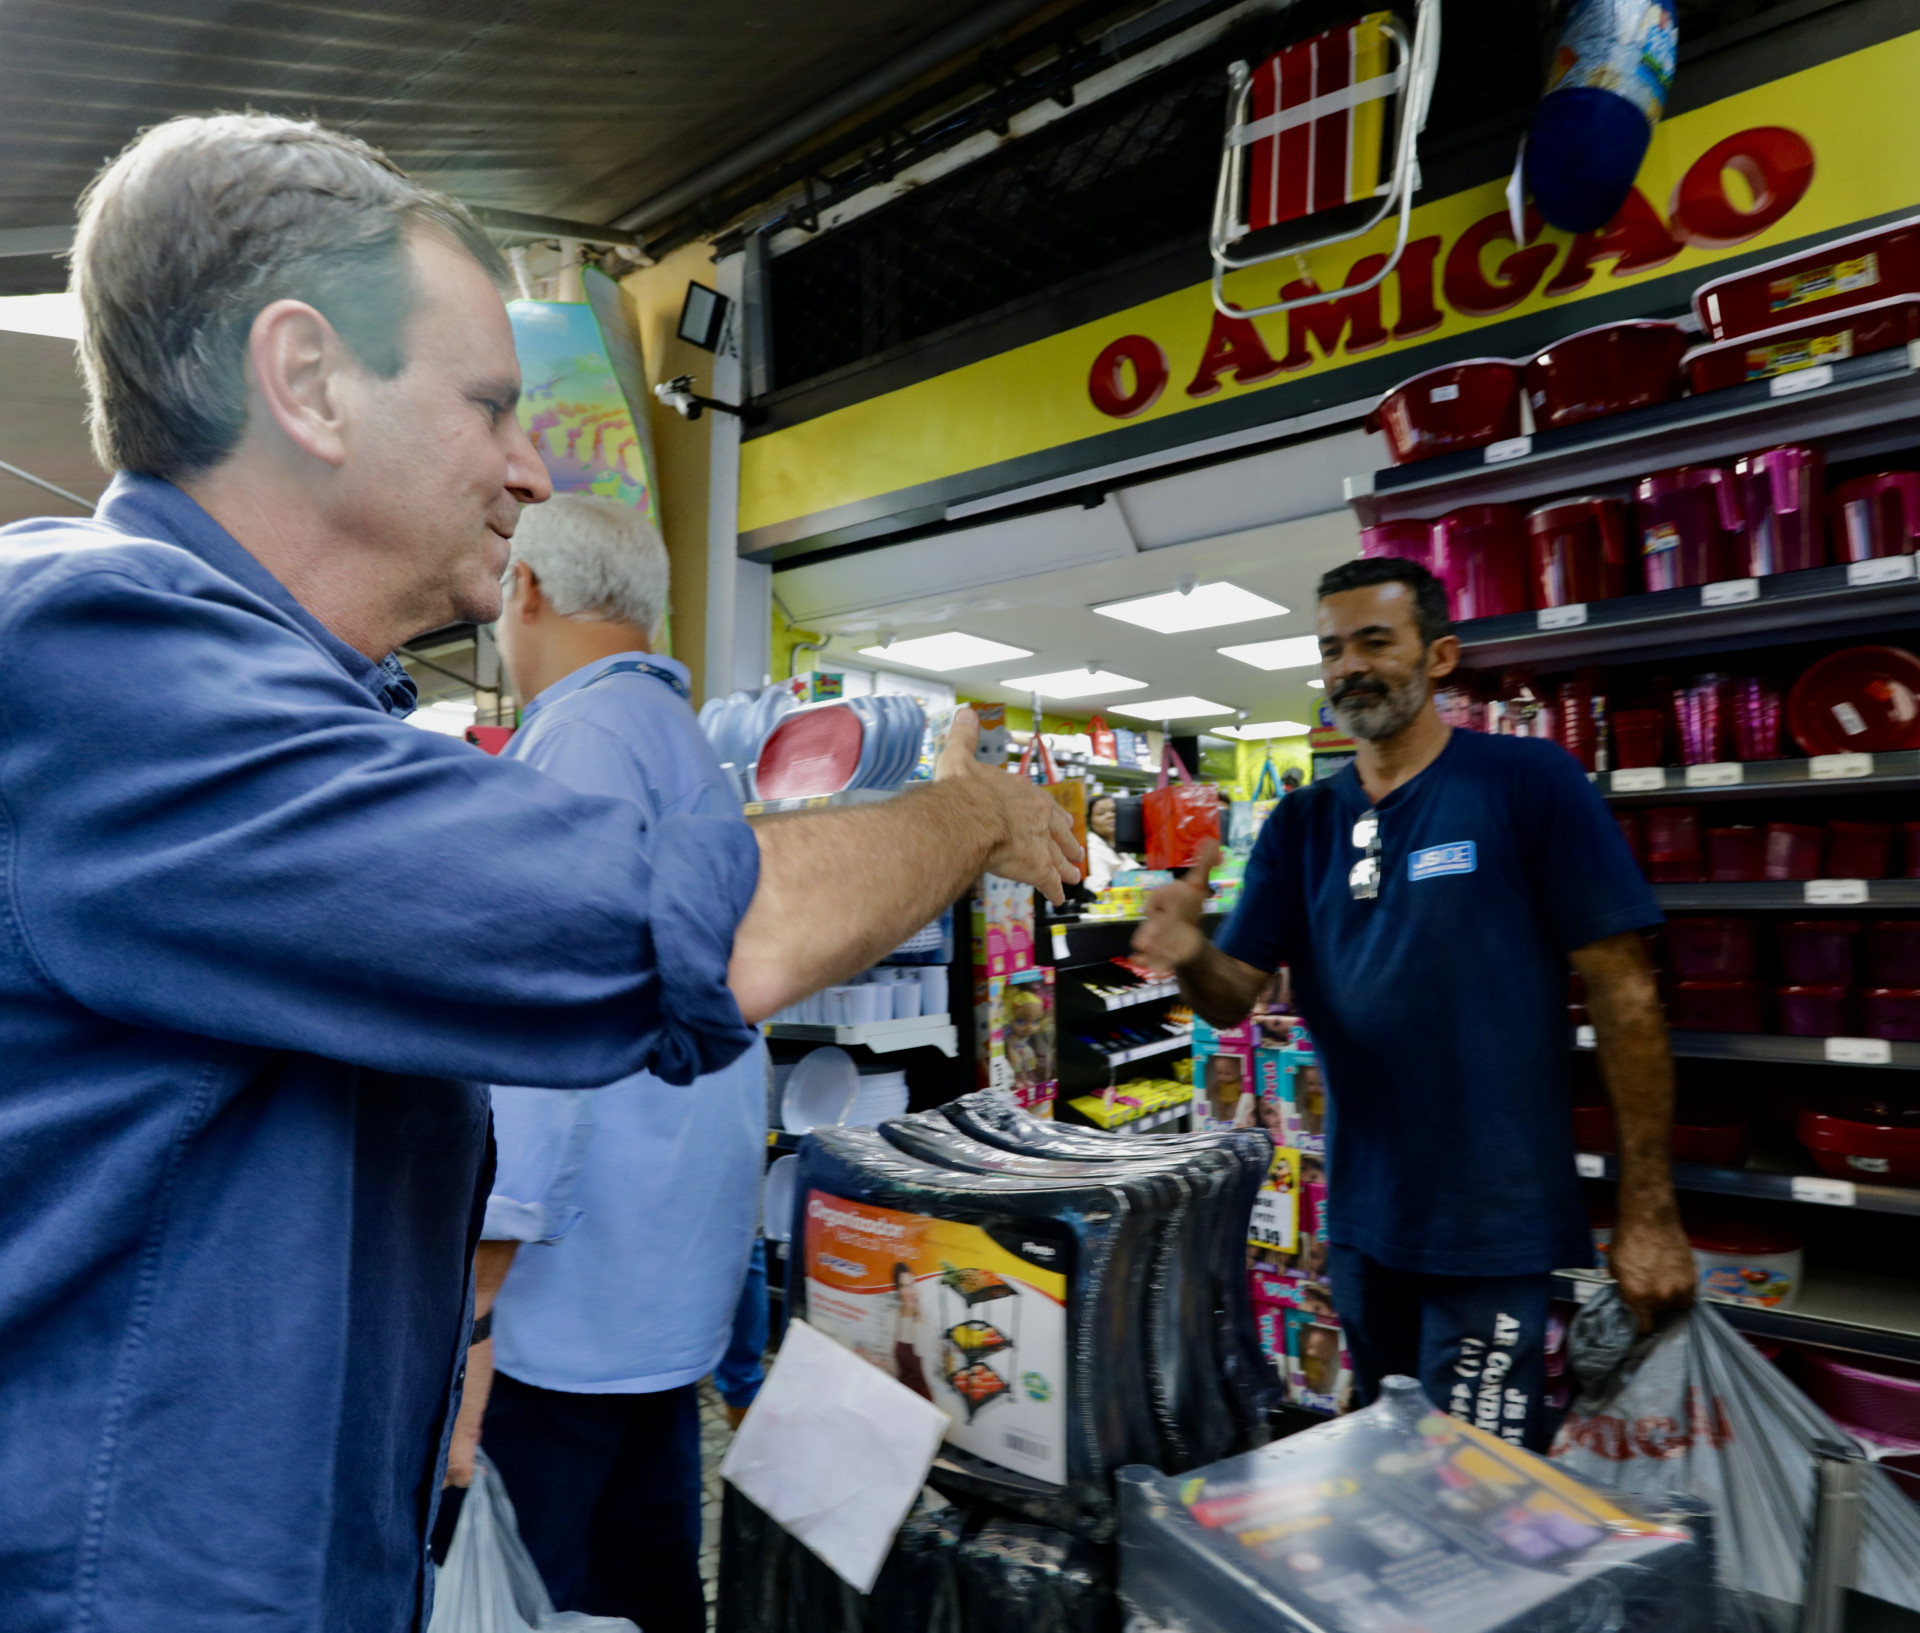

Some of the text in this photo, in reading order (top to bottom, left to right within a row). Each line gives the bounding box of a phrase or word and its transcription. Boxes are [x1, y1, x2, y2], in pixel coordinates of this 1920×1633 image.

[1088, 334, 1170, 419] O
[1474, 1312, 1522, 1436] AR CONDI
